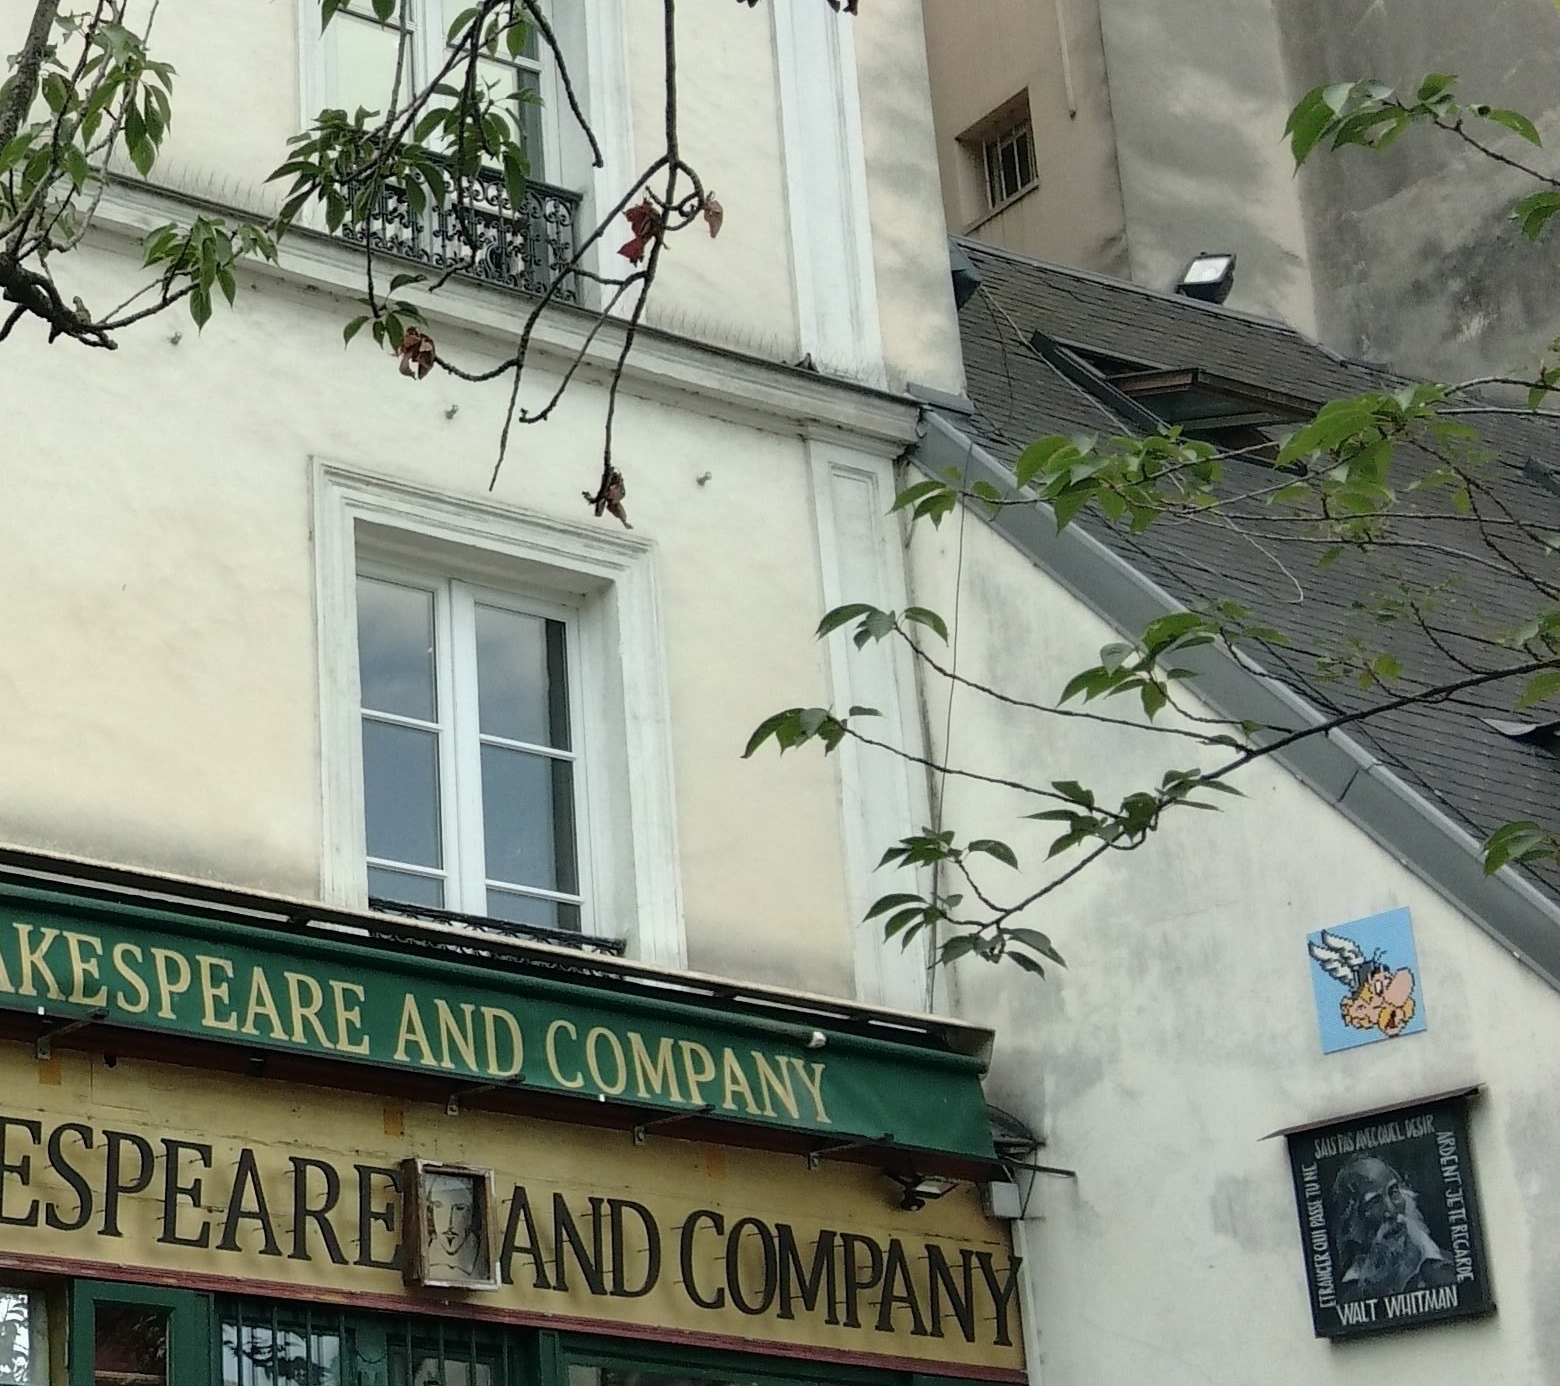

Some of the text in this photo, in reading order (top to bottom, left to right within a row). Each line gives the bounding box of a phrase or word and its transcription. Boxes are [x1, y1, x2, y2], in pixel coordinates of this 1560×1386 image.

[393, 992, 524, 1078] AND
[546, 1020, 832, 1124] COMPANY
[500, 1185, 661, 1298] AND
[680, 1209, 1022, 1347] COMPANY
[1311, 1229, 1328, 1252] QUI
[1336, 1285, 1459, 1326] WALT WHITMAN
